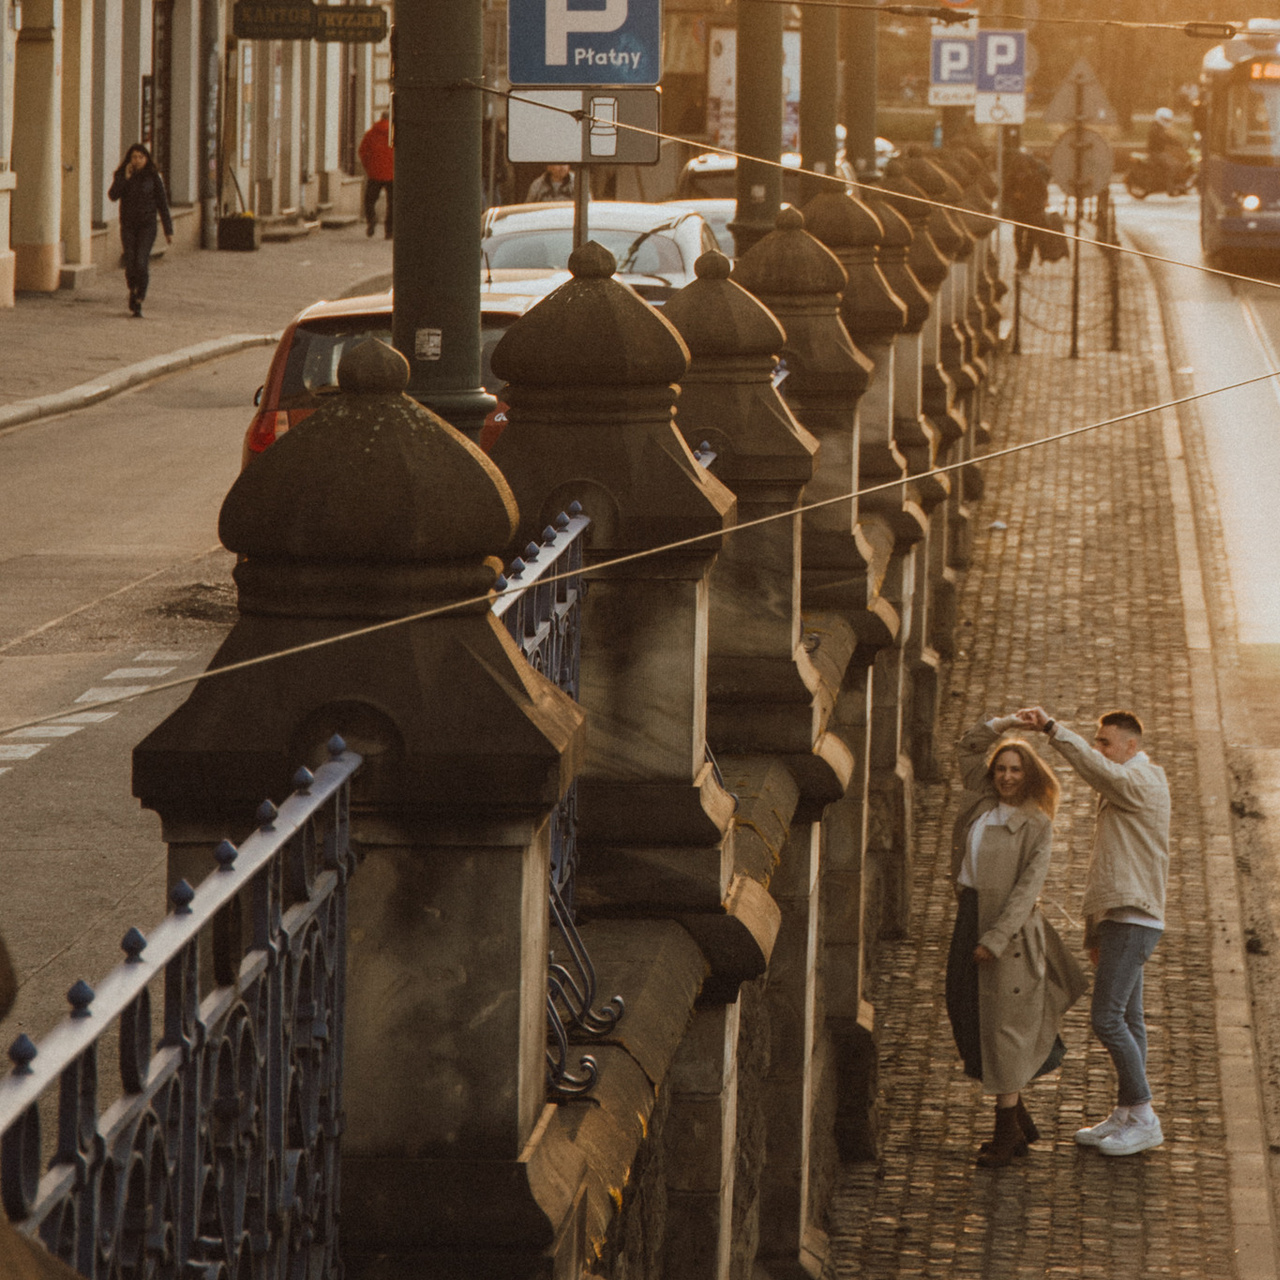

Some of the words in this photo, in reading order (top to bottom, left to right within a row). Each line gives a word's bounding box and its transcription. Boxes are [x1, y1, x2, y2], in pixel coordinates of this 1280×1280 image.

[574, 47, 642, 69] Płatny
[941, 41, 969, 81] P
[986, 34, 1017, 76] P
